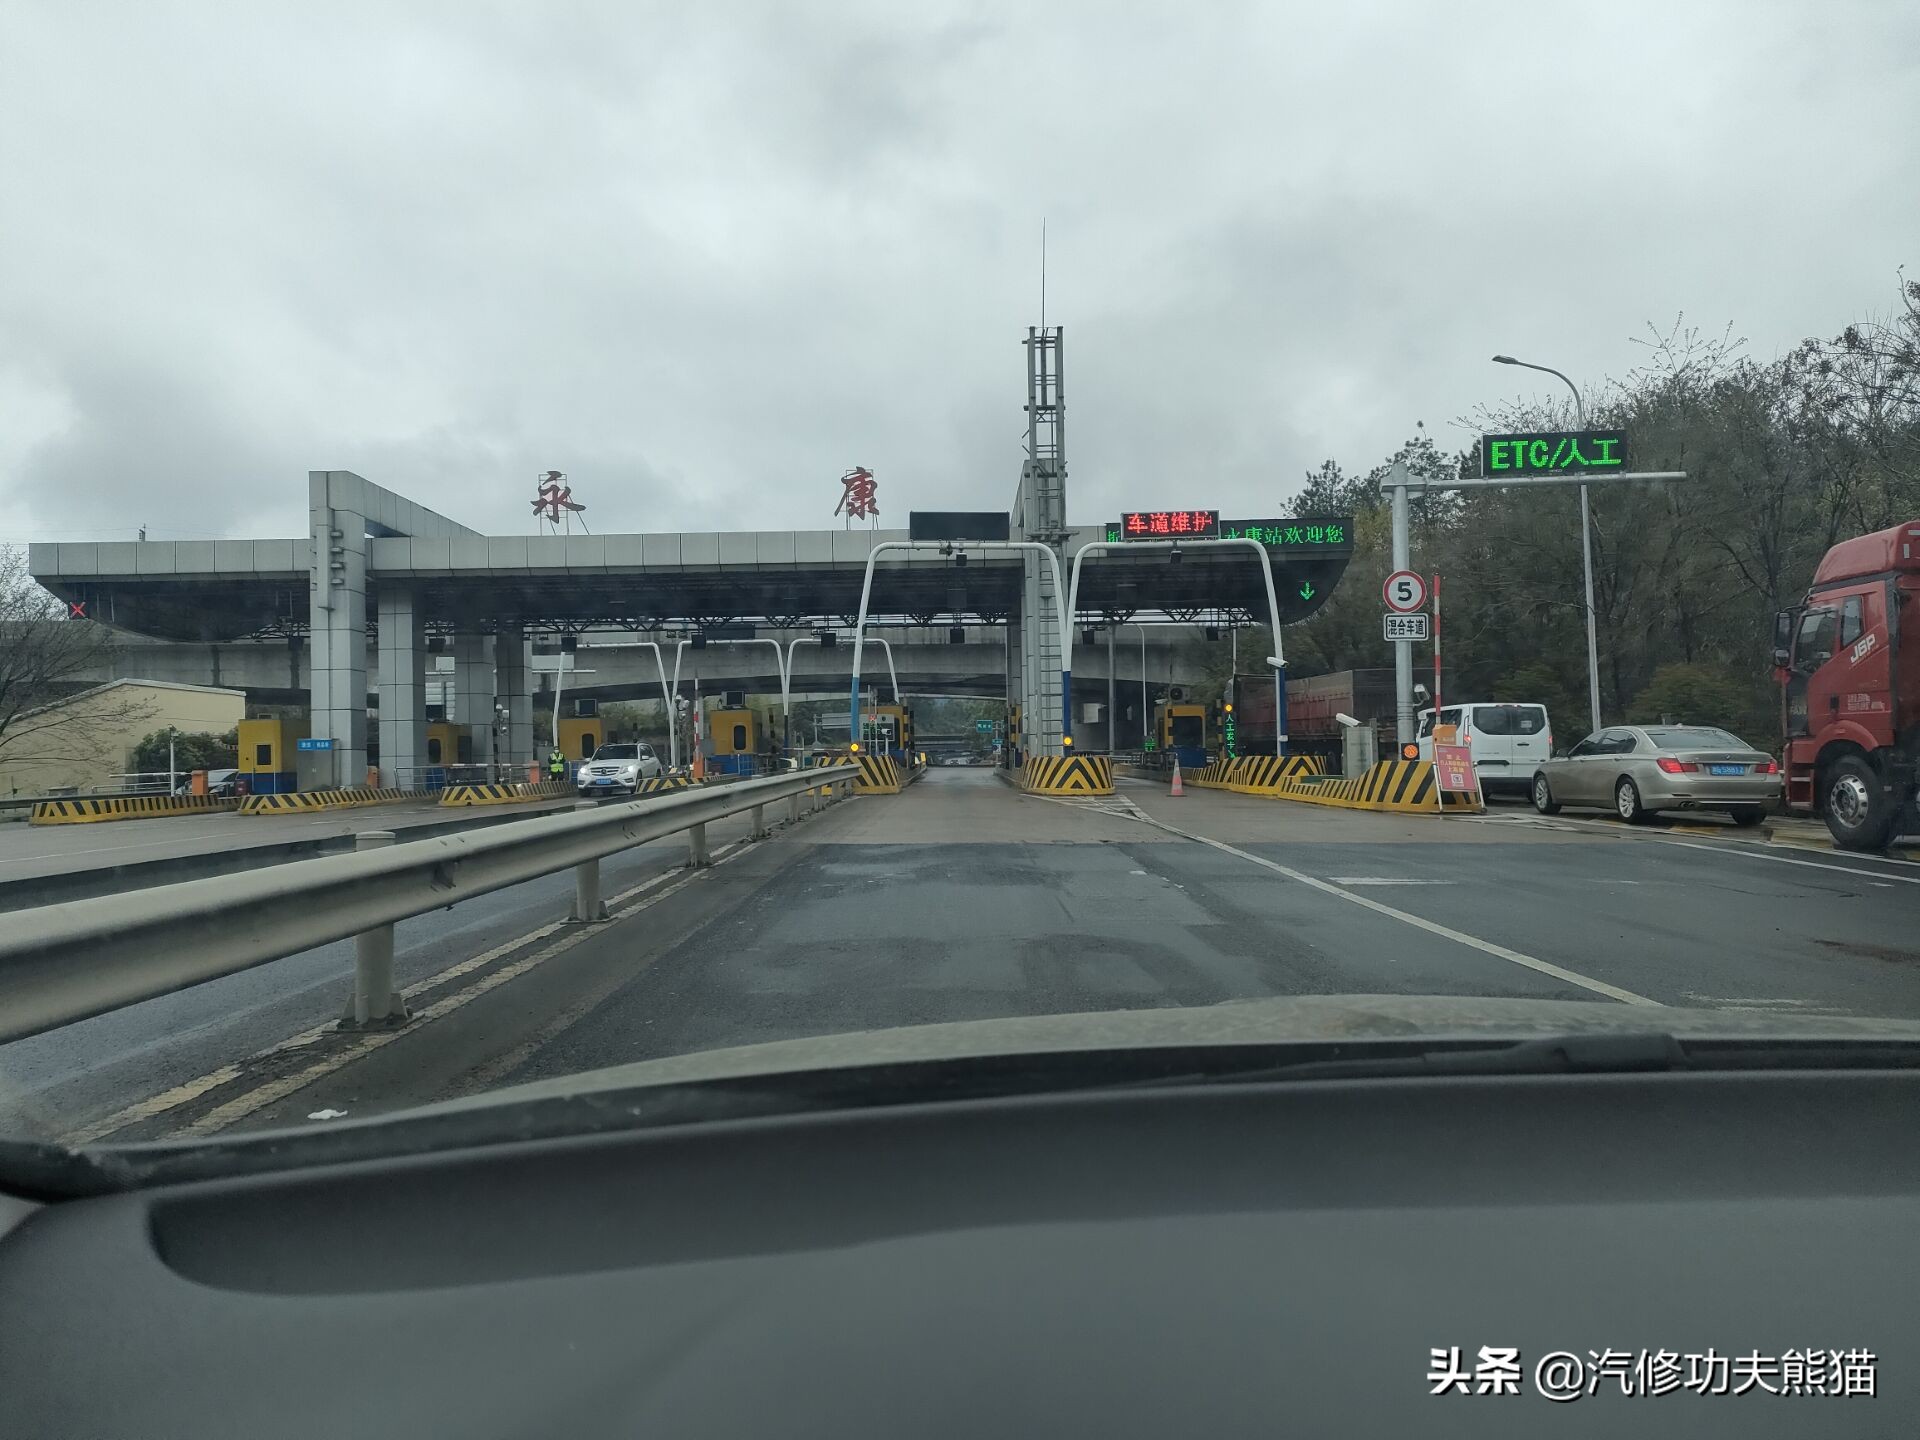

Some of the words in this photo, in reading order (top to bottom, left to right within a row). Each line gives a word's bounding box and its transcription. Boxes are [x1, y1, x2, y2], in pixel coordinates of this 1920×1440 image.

[1491, 438, 1622, 470] ETC/人工
[530, 471, 586, 523] 永
[834, 466, 880, 521] 康
[1127, 511, 1213, 534] 车道维护
[1398, 582, 1412, 602] 5
[1388, 618, 1425, 636] 混合车道
